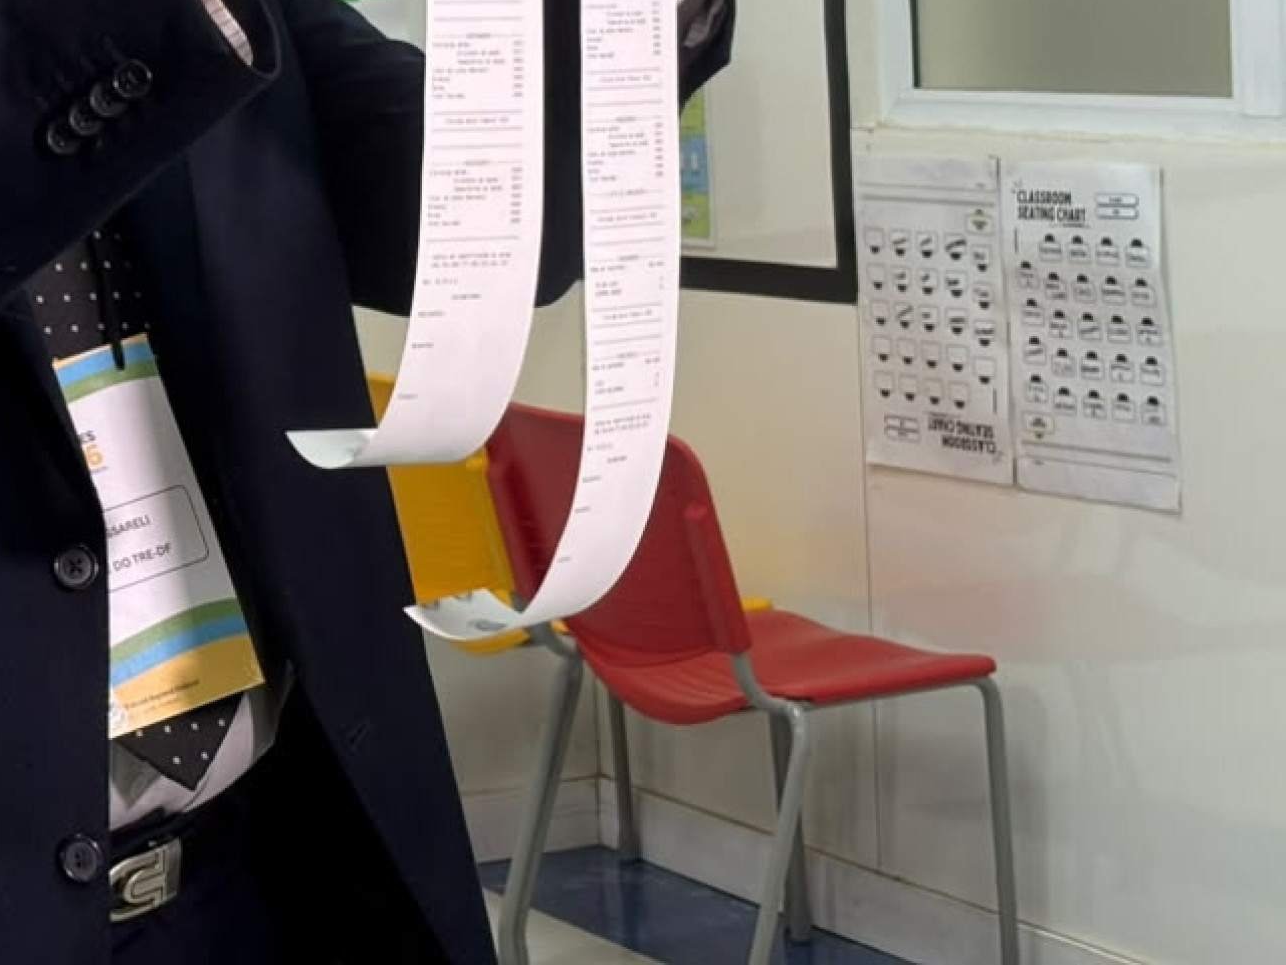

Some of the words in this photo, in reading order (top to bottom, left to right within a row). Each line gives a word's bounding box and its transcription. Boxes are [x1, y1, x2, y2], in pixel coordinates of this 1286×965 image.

[1016, 189, 1072, 205] CLASSROOM
[1017, 205, 1054, 221] SEATING
[1056, 207, 1086, 222] CHART
[113, 557, 132, 572] DO
